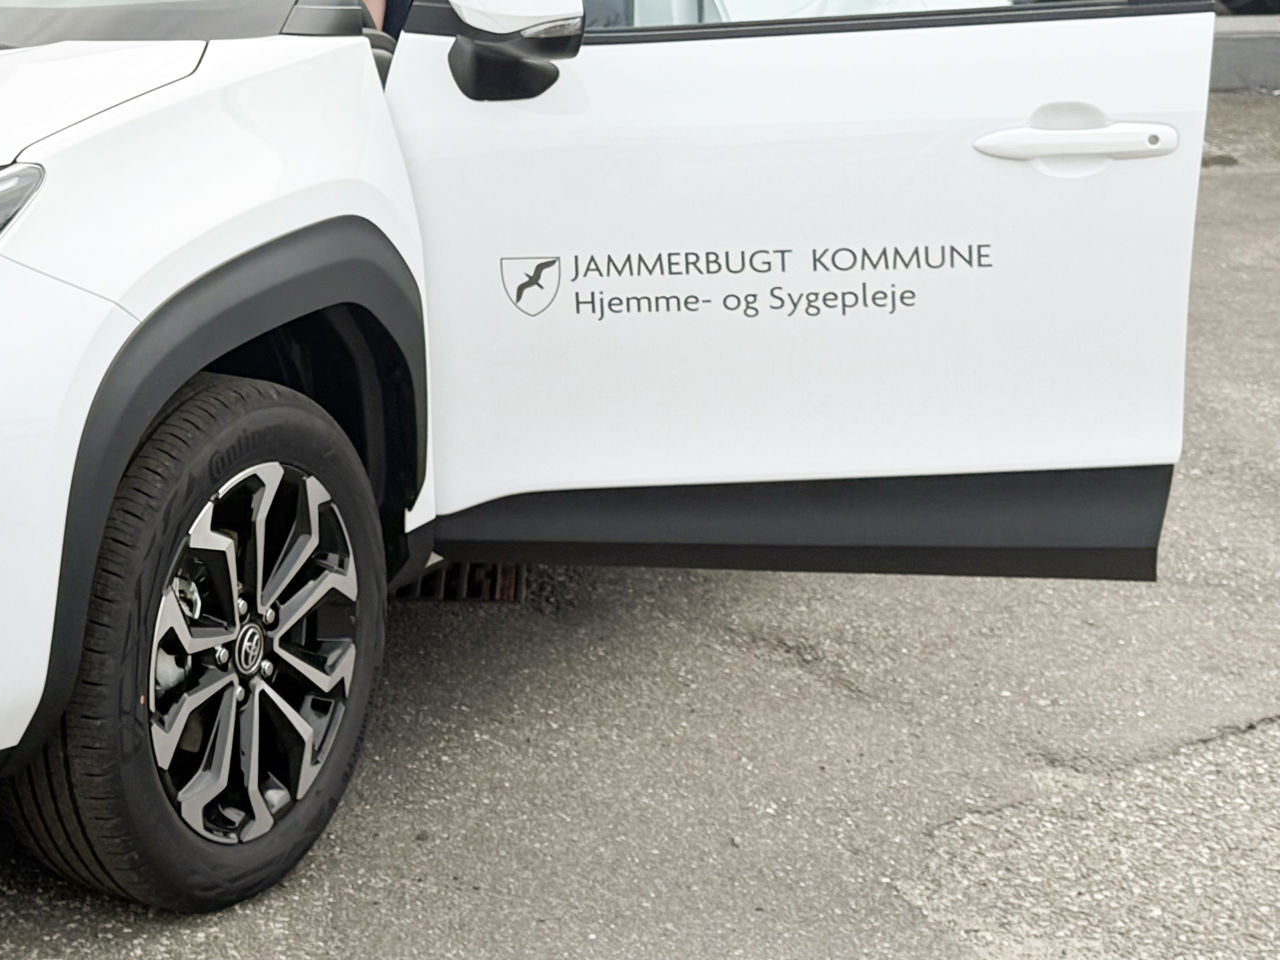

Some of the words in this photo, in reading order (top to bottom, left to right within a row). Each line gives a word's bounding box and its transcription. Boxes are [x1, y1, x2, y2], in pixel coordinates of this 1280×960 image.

[570, 249, 793, 282] JAMMERBUGT
[811, 244, 994, 272] KOMMUNE
[574, 291, 712, 321] Hjemme-
[722, 294, 759, 318] og
[769, 283, 917, 317] Sygepleje
